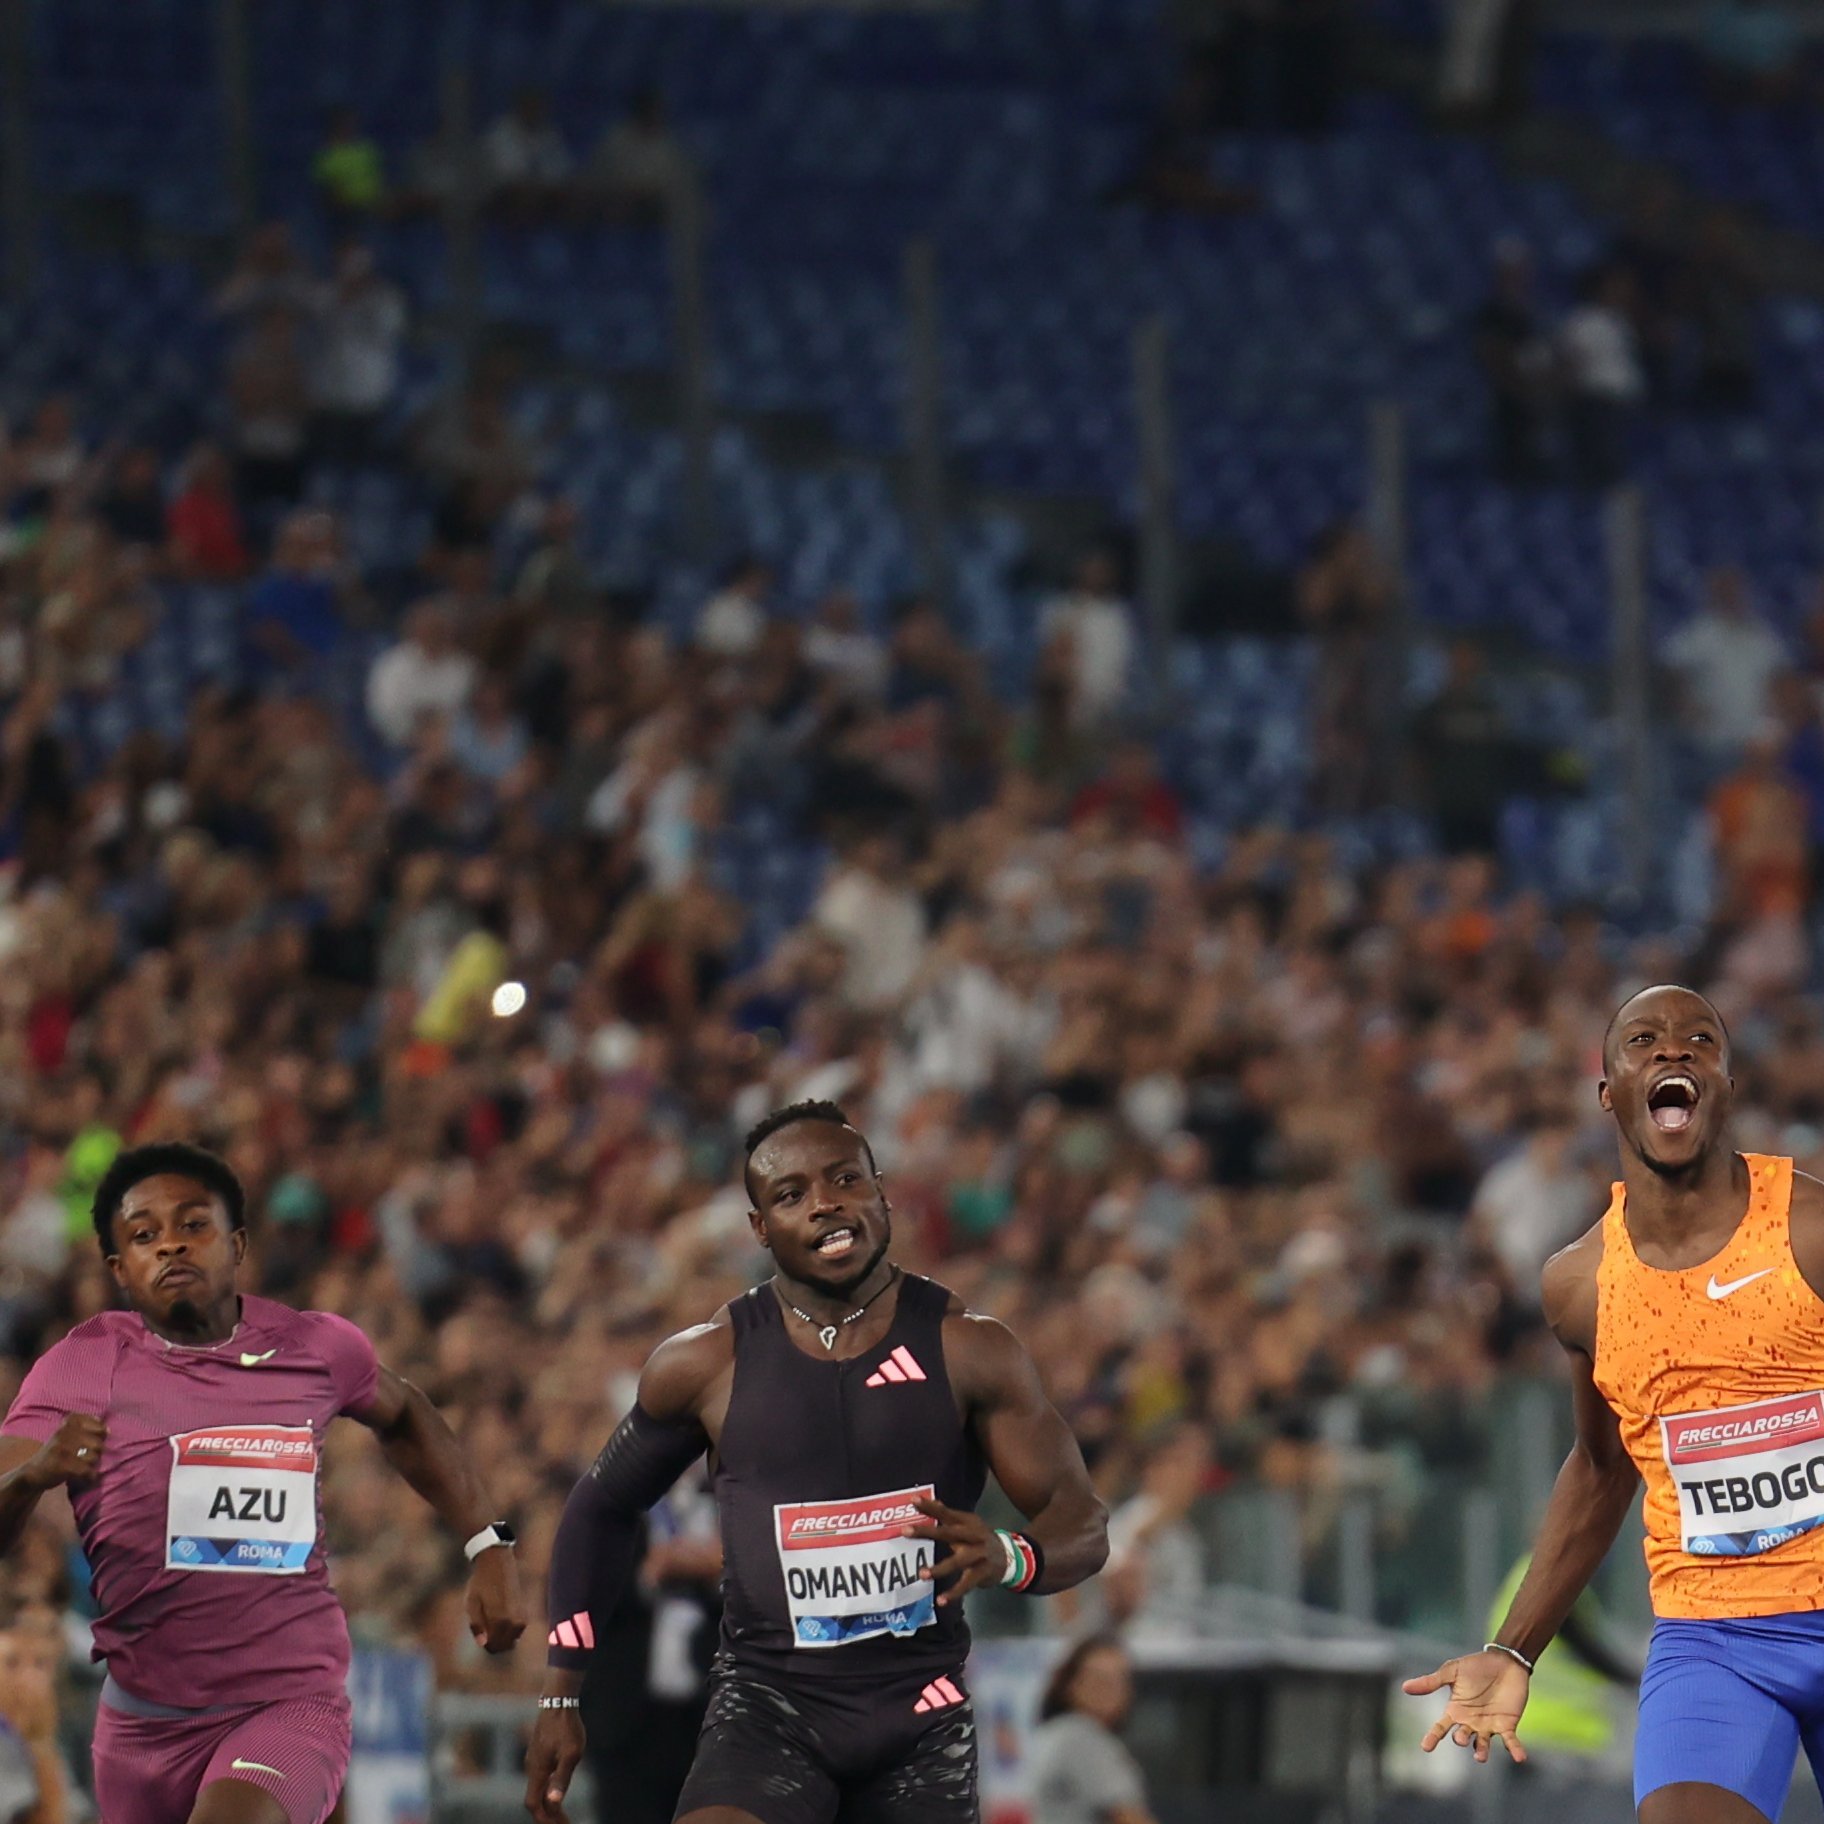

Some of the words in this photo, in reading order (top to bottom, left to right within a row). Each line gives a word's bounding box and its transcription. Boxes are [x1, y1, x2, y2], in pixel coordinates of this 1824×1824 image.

[1677, 1406, 1819, 1445] FRECCIAROSSA
[208, 1486, 287, 1523] AZU
[791, 1503, 921, 1532] FRECCIAROSS
[237, 1544, 284, 1559] ROMA
[787, 1546, 929, 1600] OMANYALA
